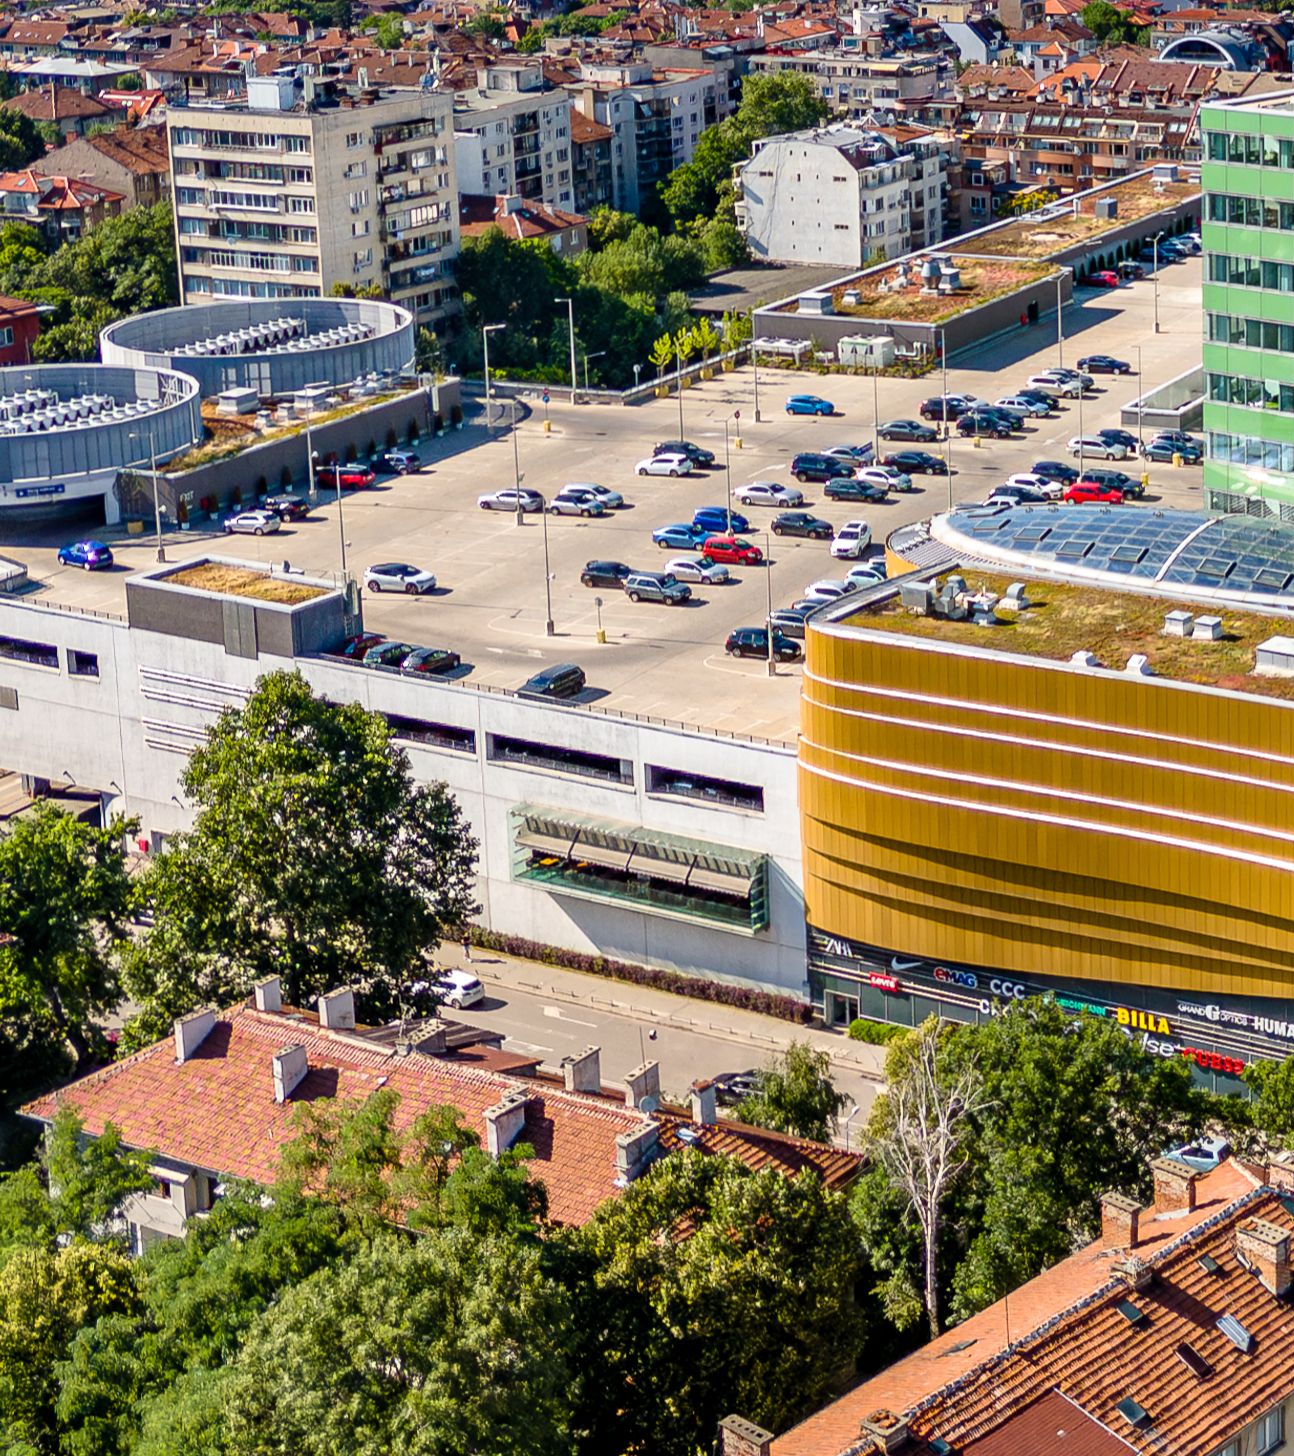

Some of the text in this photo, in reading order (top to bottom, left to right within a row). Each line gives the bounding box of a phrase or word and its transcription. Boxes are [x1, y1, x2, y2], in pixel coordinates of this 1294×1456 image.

[990, 979, 1025, 1000] CCC
[1055, 998, 1106, 1016] EICHANN
[1117, 1007, 1170, 1035] BILLA
